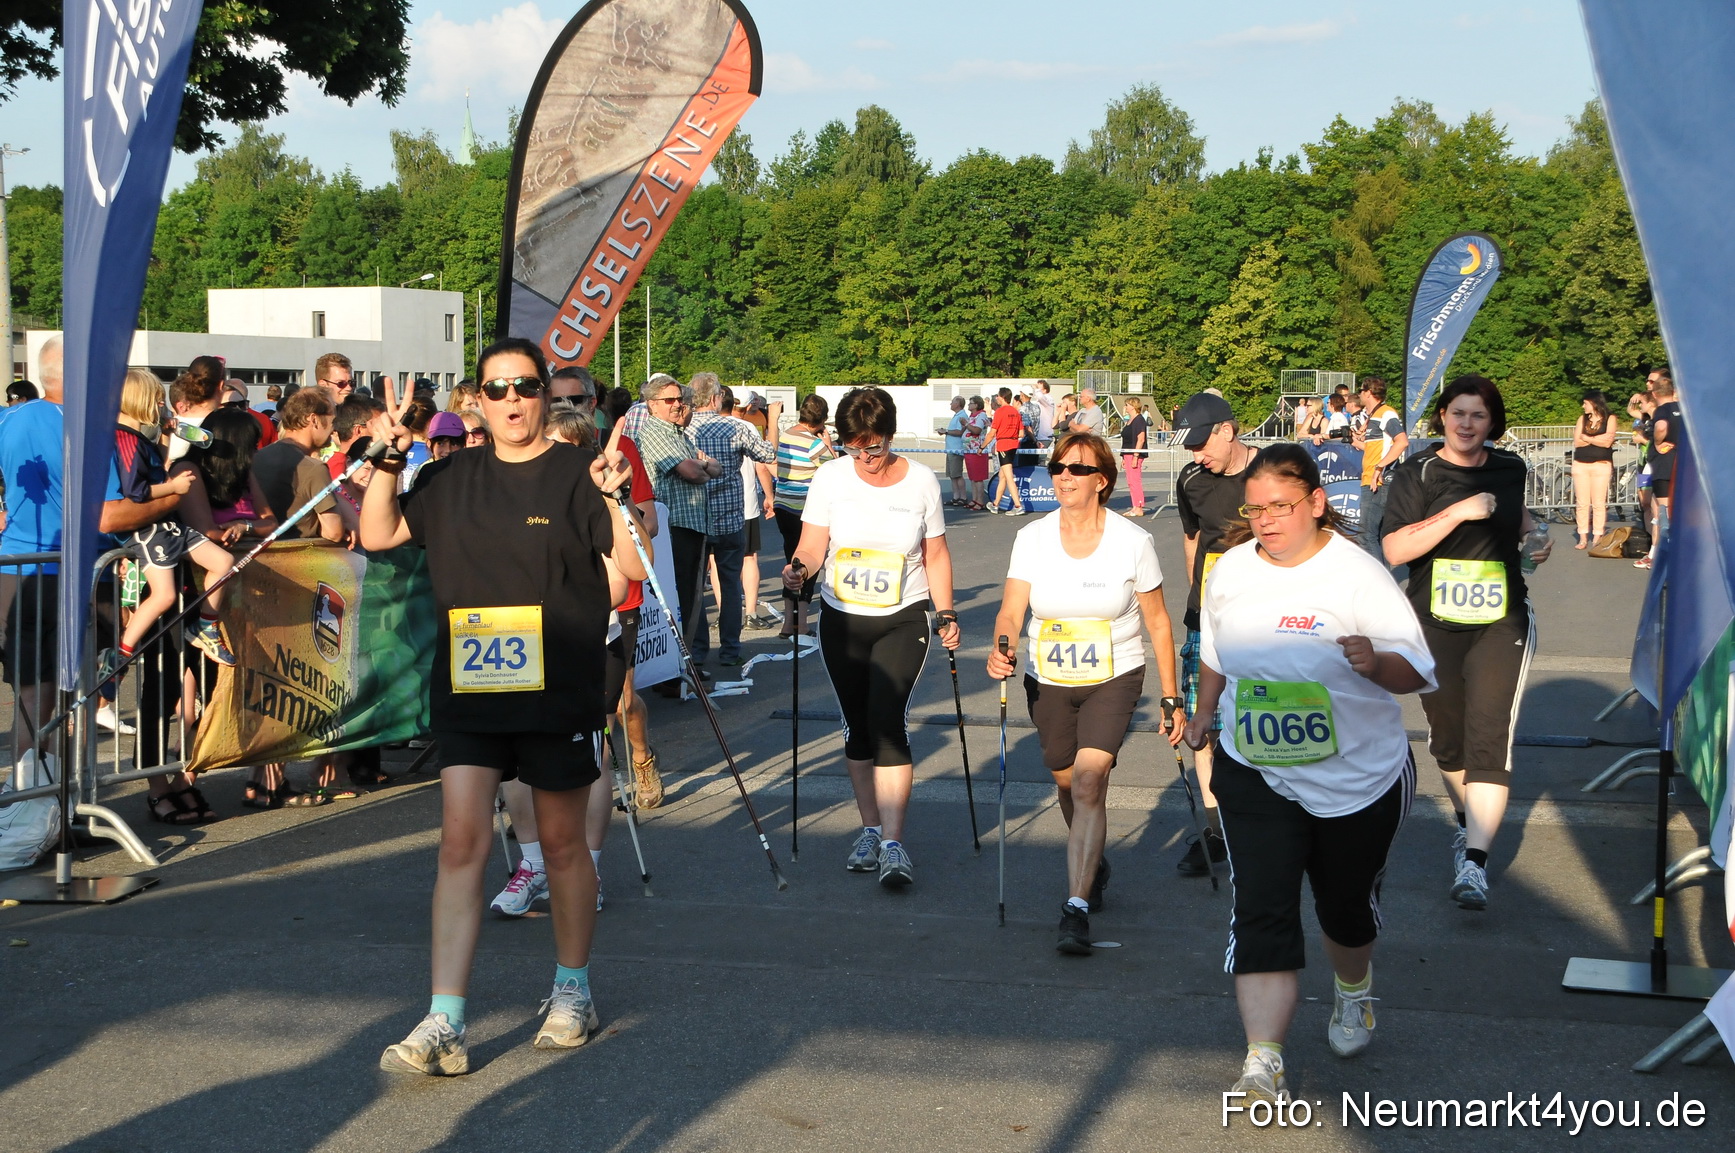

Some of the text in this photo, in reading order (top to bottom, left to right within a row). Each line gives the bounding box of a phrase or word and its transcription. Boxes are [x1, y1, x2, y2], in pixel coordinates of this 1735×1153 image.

[1412, 276, 1476, 360] Frischmann
[526, 516, 550, 525] Sylvia
[843, 567, 889, 593] 415
[1435, 582, 1503, 608] 1085
[638, 606, 660, 630] arkter
[462, 637, 527, 671] 243
[1047, 643, 1100, 669] 414
[1238, 712, 1330, 746] 1066
